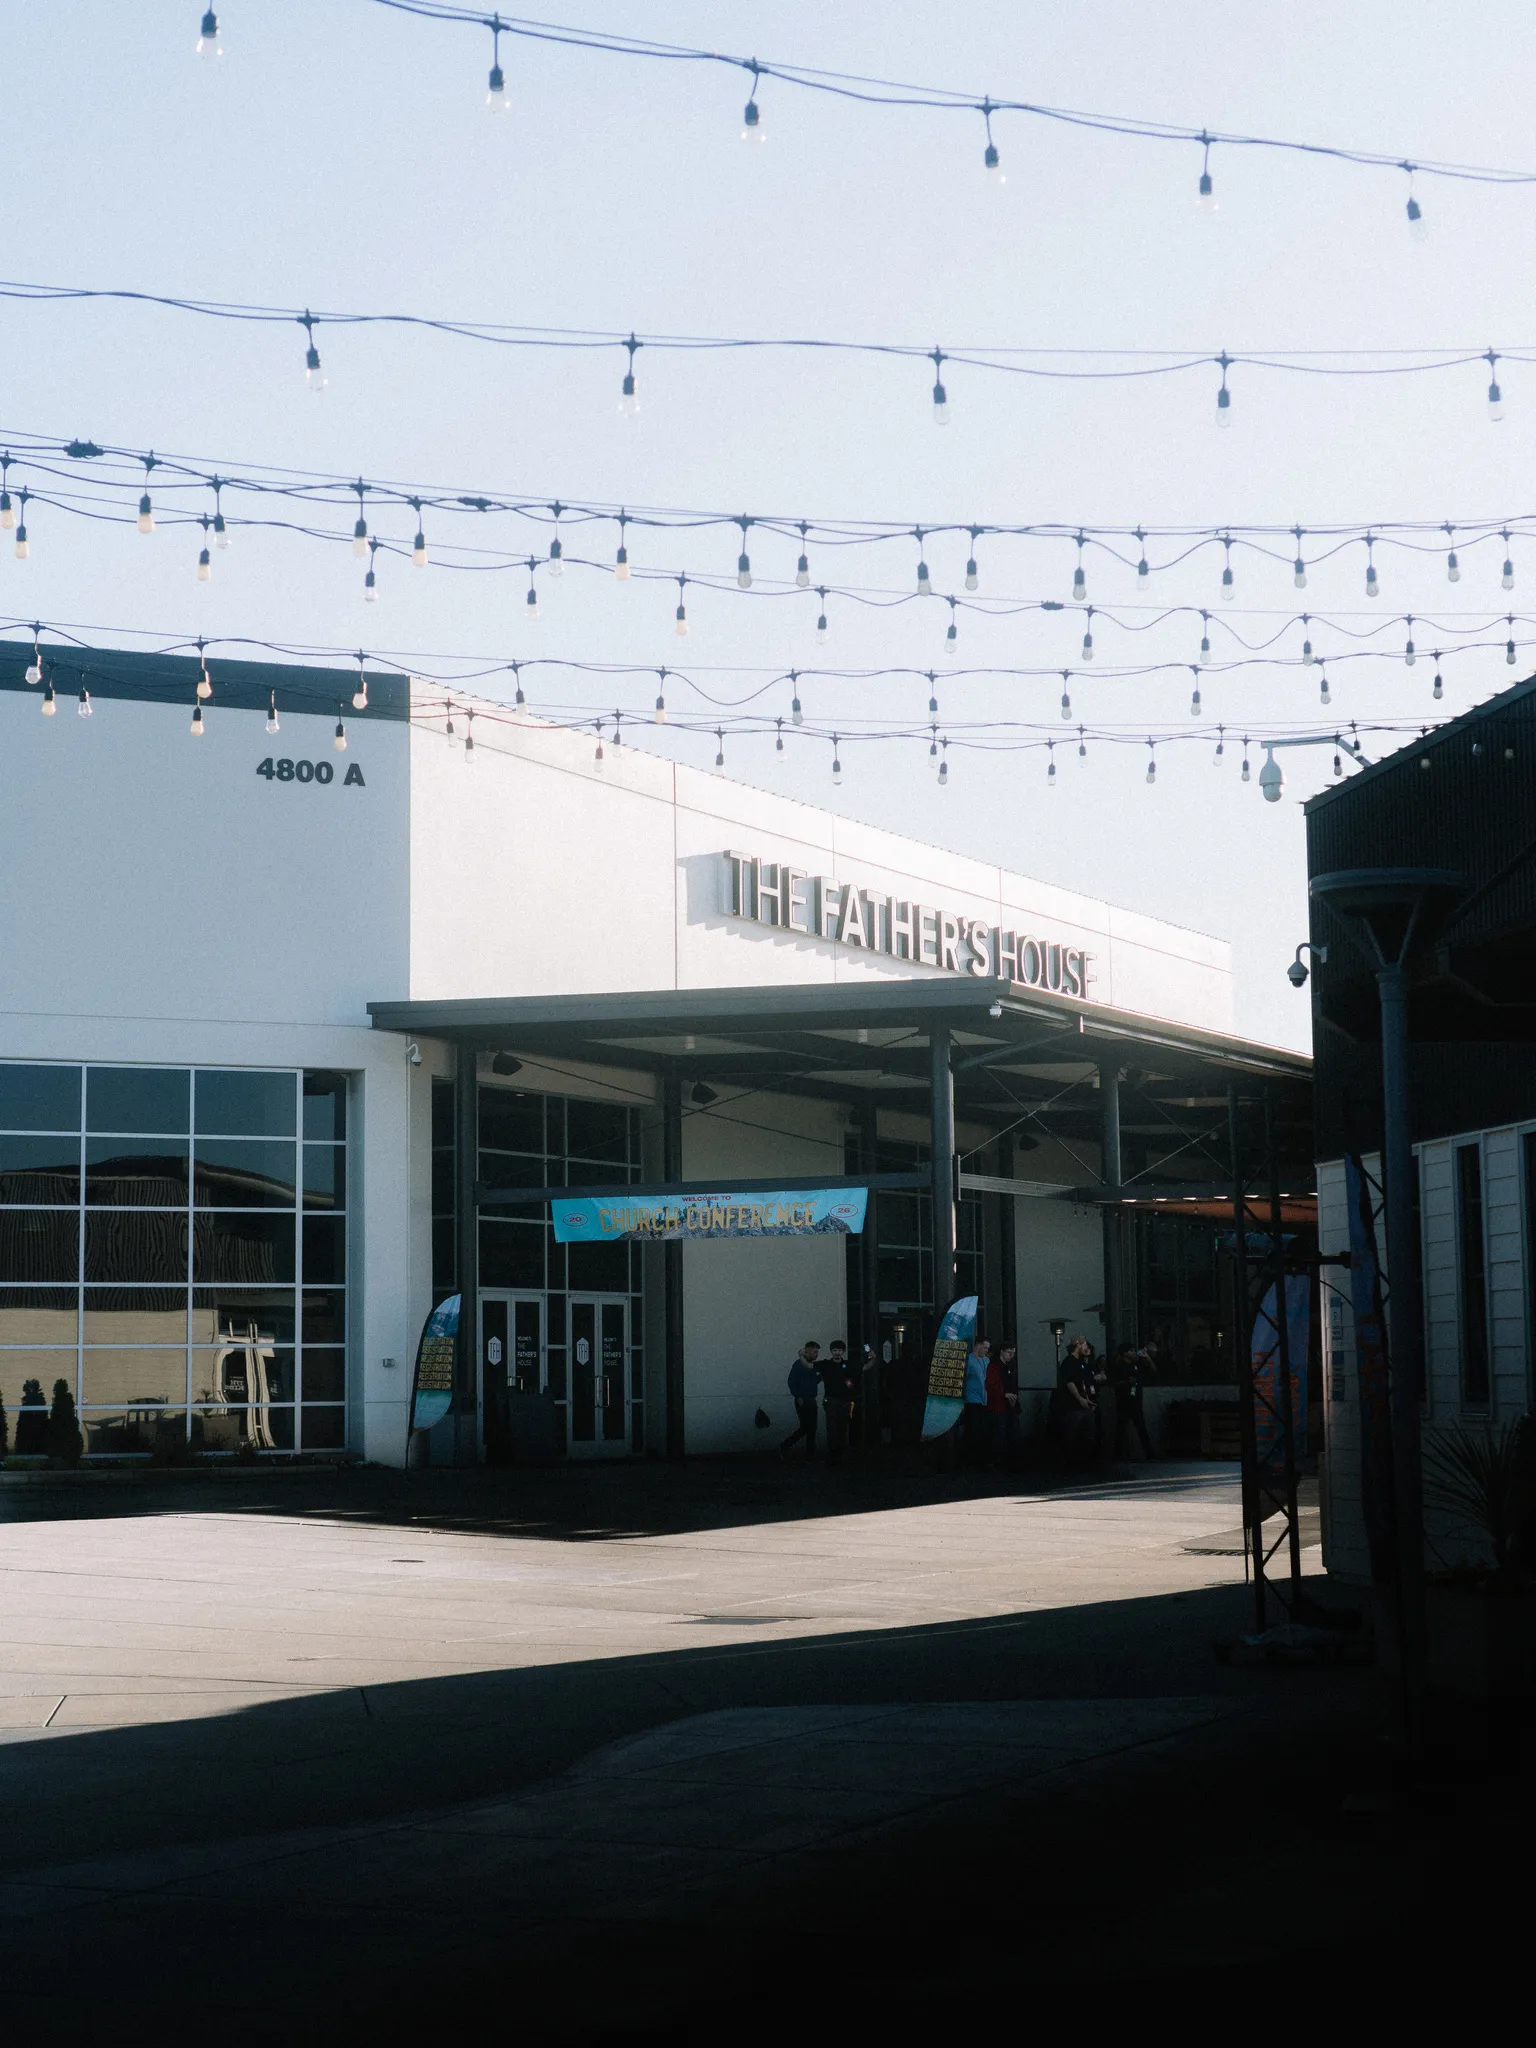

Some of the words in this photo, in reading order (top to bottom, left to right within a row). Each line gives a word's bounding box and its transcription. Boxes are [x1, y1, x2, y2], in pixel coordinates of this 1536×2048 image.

[256, 757, 334, 784] 4800
[343, 763, 366, 787] A
[723, 849, 808, 933] THE
[813, 875, 991, 978] FATHER'S
[992, 926, 1099, 1002] HOUSE
[599, 1205, 680, 1233] CHURCH
[687, 1201, 818, 1231] CONFERENCE
